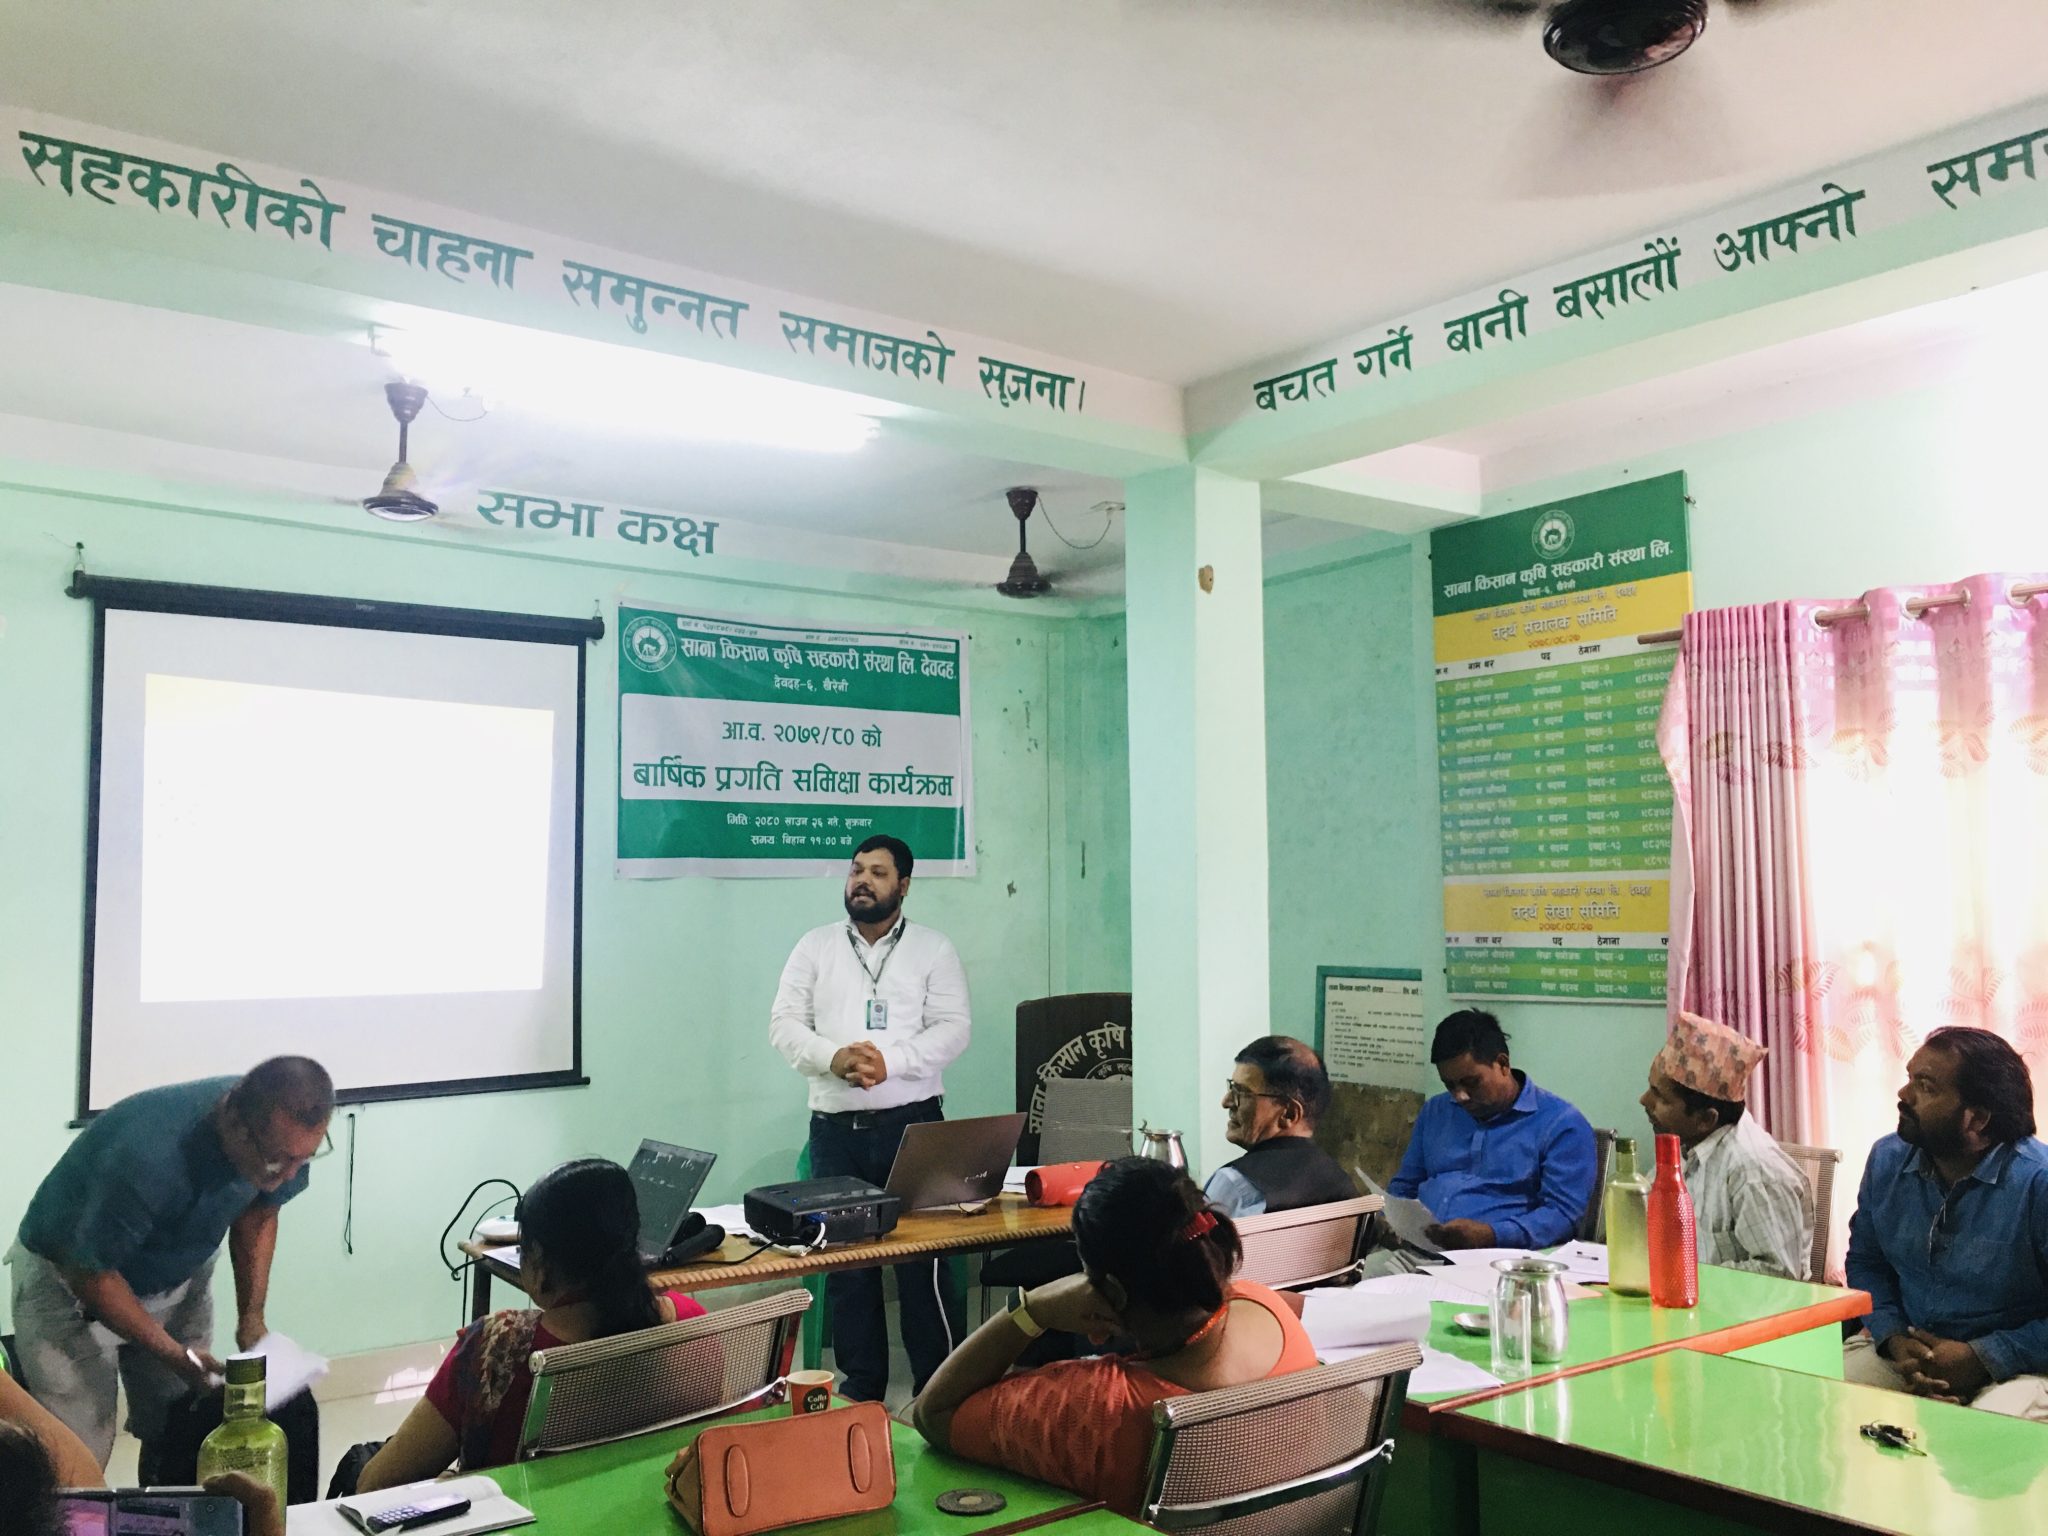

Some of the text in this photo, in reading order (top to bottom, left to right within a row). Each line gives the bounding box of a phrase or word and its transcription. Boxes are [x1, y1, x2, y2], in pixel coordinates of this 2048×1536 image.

[18, 131, 346, 251] सहकारीको
[371, 213, 534, 290] चाहना
[562, 259, 750, 335] समुन्नत
[780, 310, 956, 385] समाजको
[1253, 127, 2048, 411] बचत गर्ने बानी बसालौं आफ्नो सम
[476, 488, 720, 558] सभा कक्ष
[1443, 539, 1674, 598] साना किसान कृषि सहकारी संस्था लि.
[681, 637, 716, 658] साना
[720, 637, 770, 662] किसान
[772, 643, 803, 669] कृषि
[805, 648, 859, 670] सहकारी
[863, 650, 895, 672] संस्था
[722, 721, 883, 747] आ.व. २०७९/८० को
[715, 760, 783, 791] प्रगति
[792, 762, 861, 794] समिक्षा
[868, 765, 954, 796] कार्यक्रम
[755, 816, 780, 827] २०८०
[811, 817, 824, 828] २६
[1579, 901, 1621, 921] समिति
[1086, 1021, 1126, 1060] कृषि
